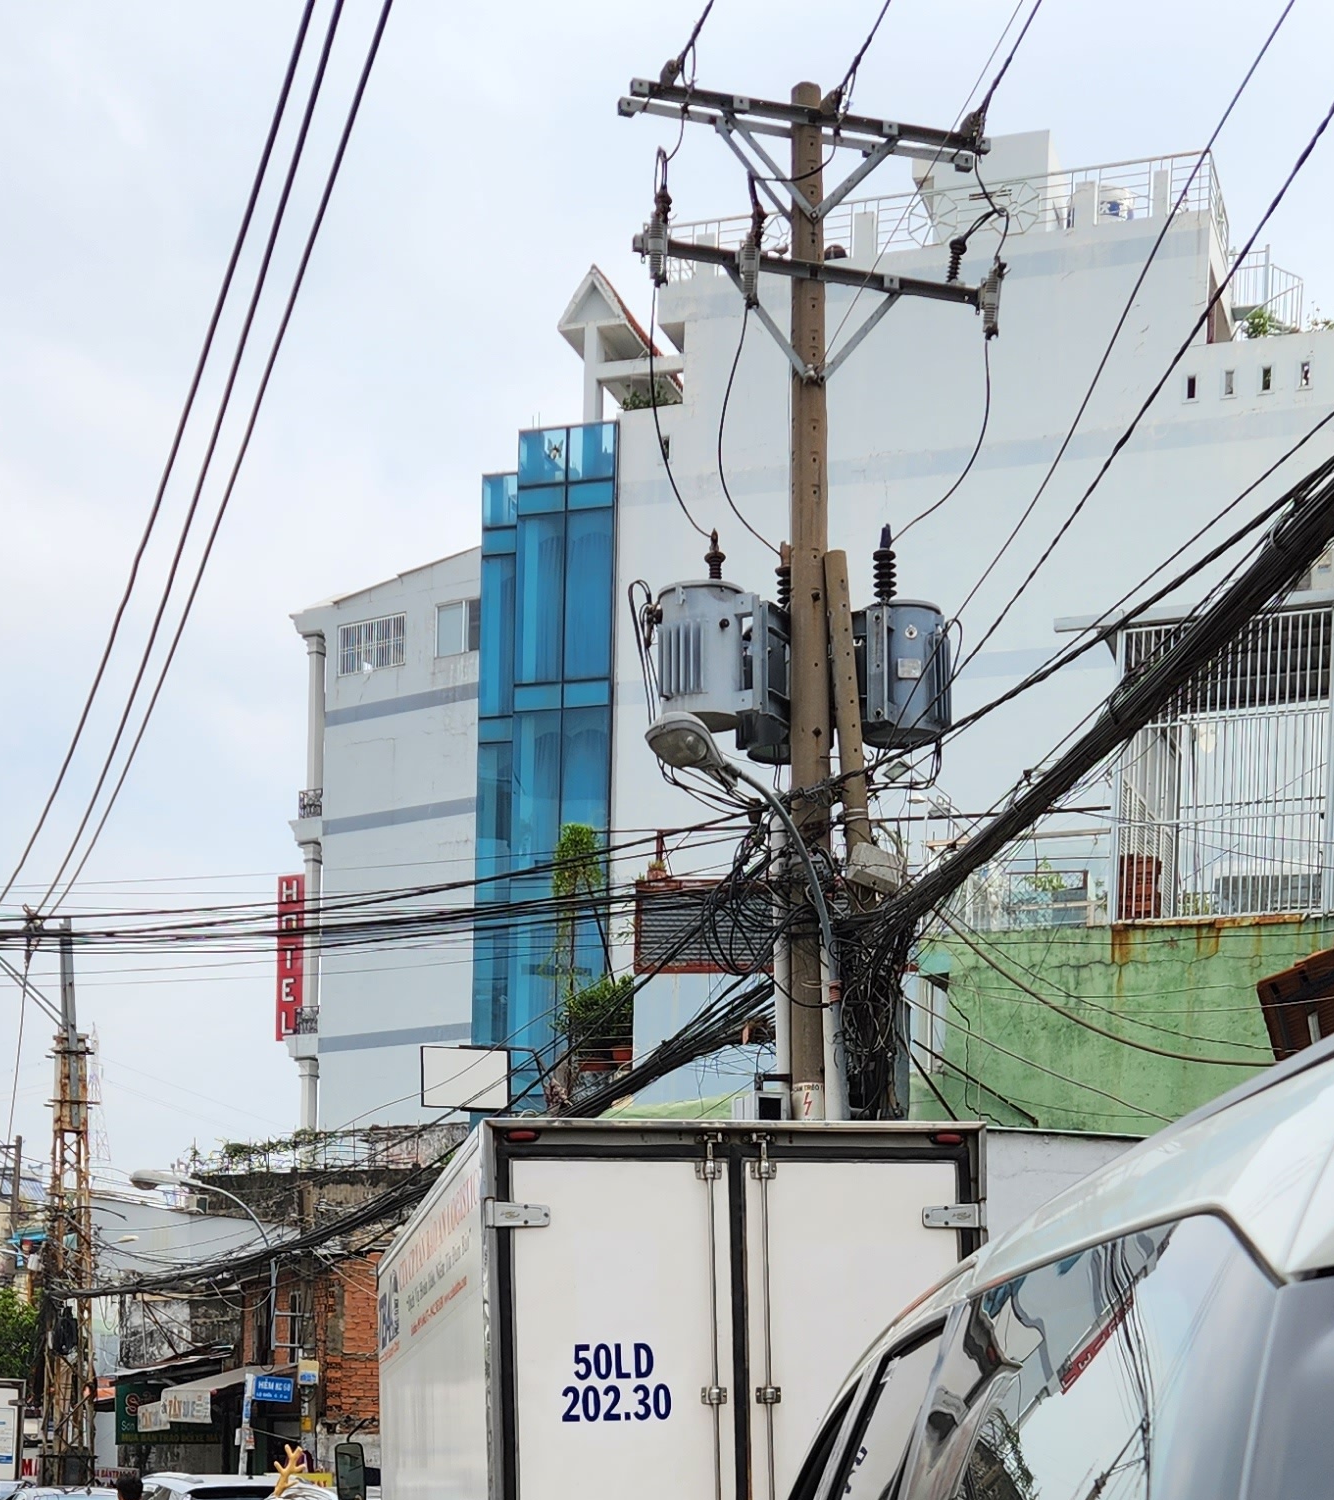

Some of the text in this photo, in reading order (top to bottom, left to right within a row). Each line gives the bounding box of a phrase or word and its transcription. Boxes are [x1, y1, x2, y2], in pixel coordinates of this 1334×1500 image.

[281, 879, 298, 1035] HOTEL
[573, 1342, 655, 1381] 50LD
[561, 1383, 672, 1422] 202.30
